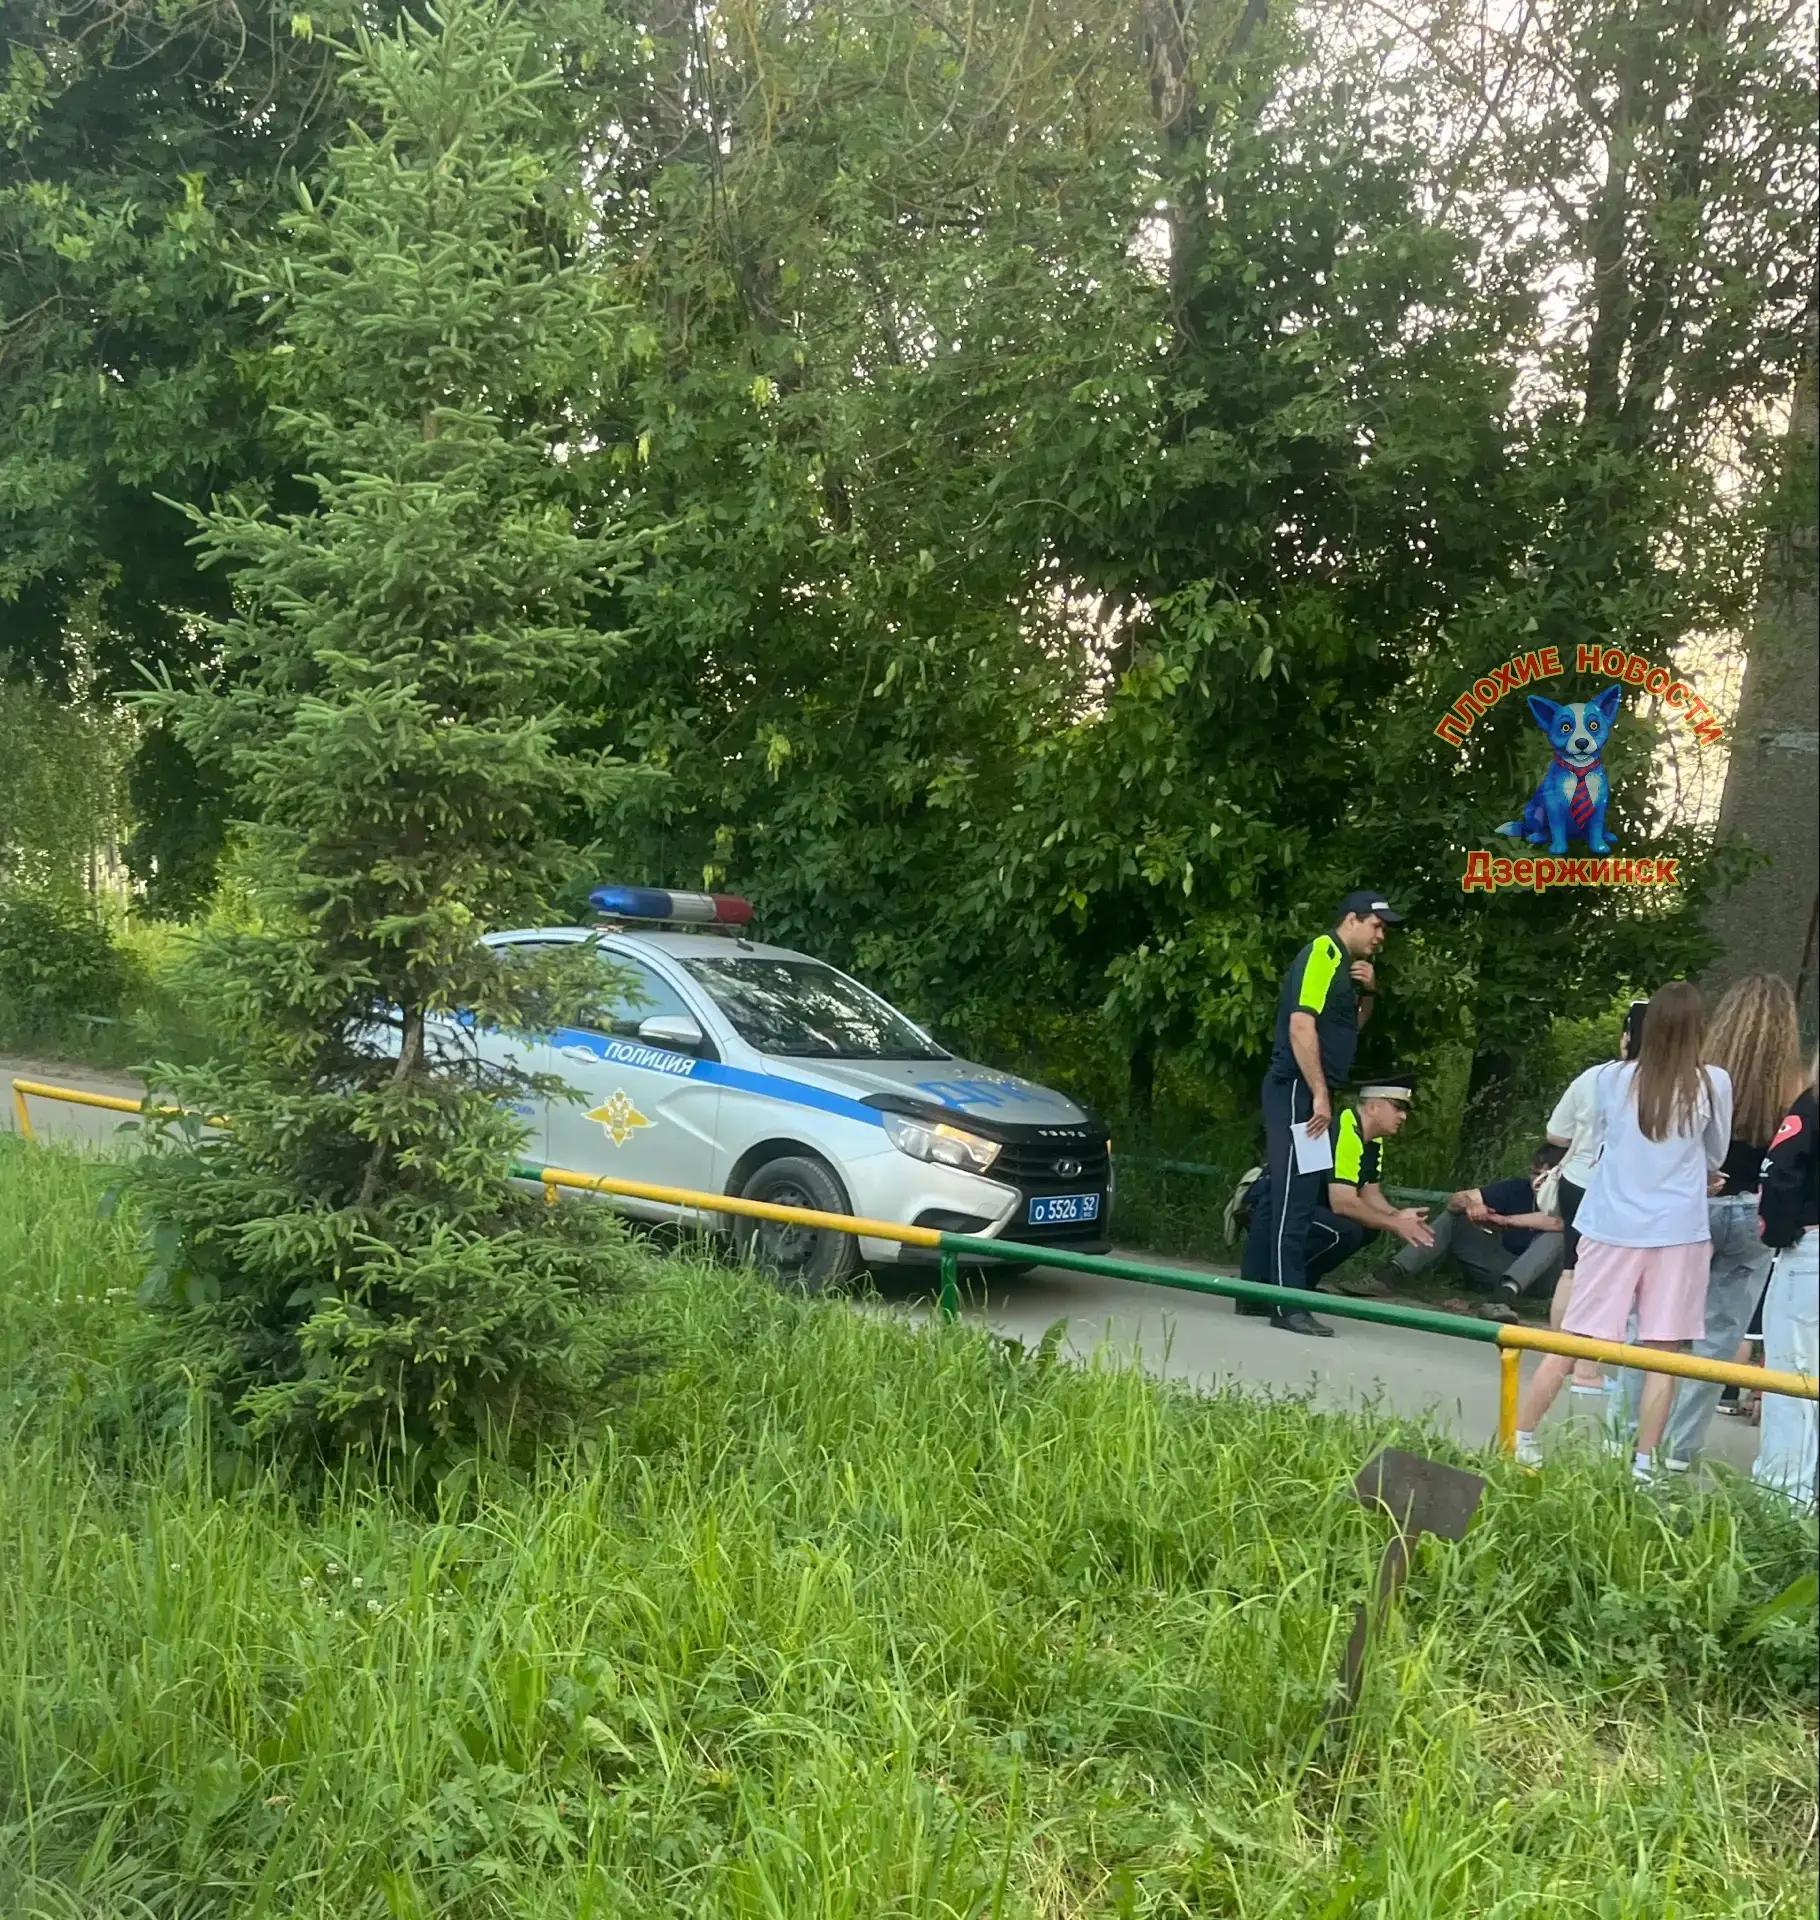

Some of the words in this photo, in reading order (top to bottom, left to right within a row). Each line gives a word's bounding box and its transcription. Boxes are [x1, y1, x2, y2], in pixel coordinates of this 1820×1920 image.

[604, 1042, 696, 1076] ПОЛИЦИЯ
[1048, 1199, 1077, 1219] 5526
[1083, 1196, 1095, 1211] 52
